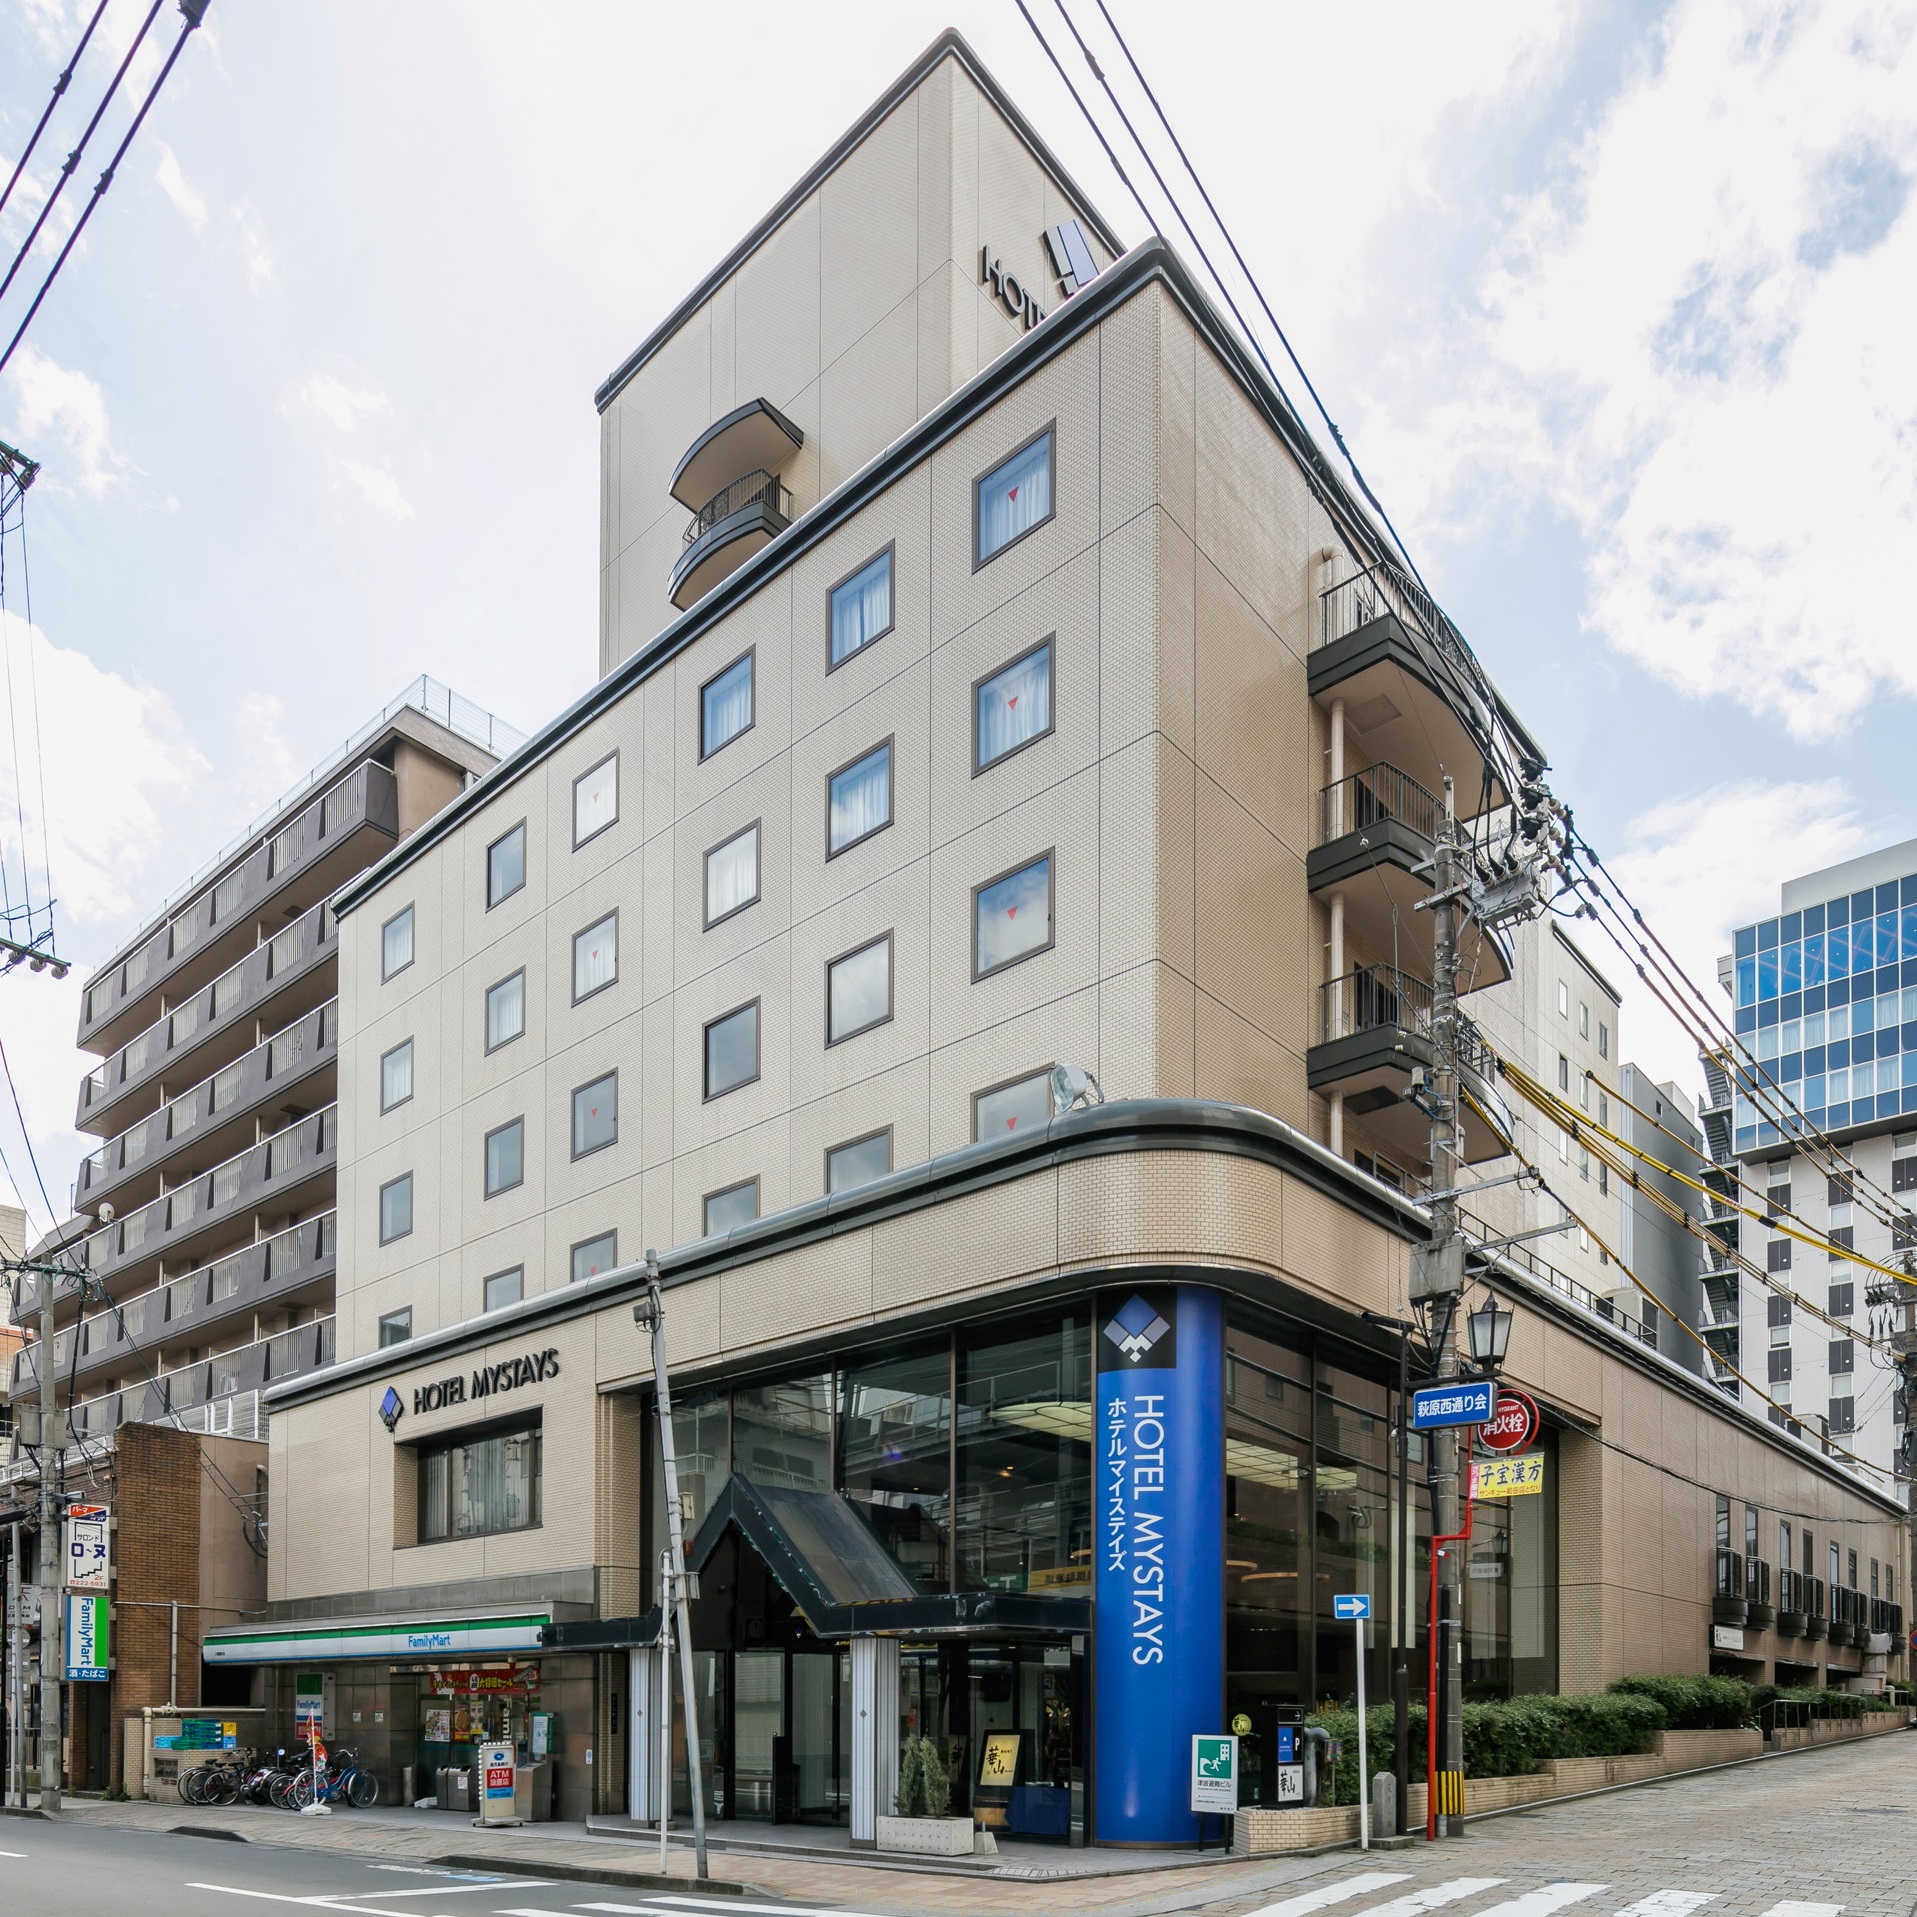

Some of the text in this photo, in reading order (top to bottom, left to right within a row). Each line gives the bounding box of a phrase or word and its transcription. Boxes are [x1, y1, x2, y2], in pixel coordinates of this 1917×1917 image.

[414, 1347, 559, 1415] HOTEL MYSTAYS
[1417, 1393, 1487, 1418] 萩原西通り会
[1483, 1413, 1525, 1436] 消火栓
[1108, 1397, 1128, 1571] ホテルマイステイズ
[1480, 1461, 1542, 1486] 子宝漢方
[72, 1505, 88, 1513] パーマ
[77, 1533, 99, 1541] サロンド
[1132, 1395, 1164, 1665] HOTEL MYSTAYS
[78, 1597, 93, 1665] FamilyMart
[408, 1634, 451, 1650] FamilyMart
[1294, 1737, 1300, 1751] P
[986, 1744, 1005, 1775] 華山
[490, 1769, 510, 1778] ATM
[1279, 1769, 1296, 1797] 華山
